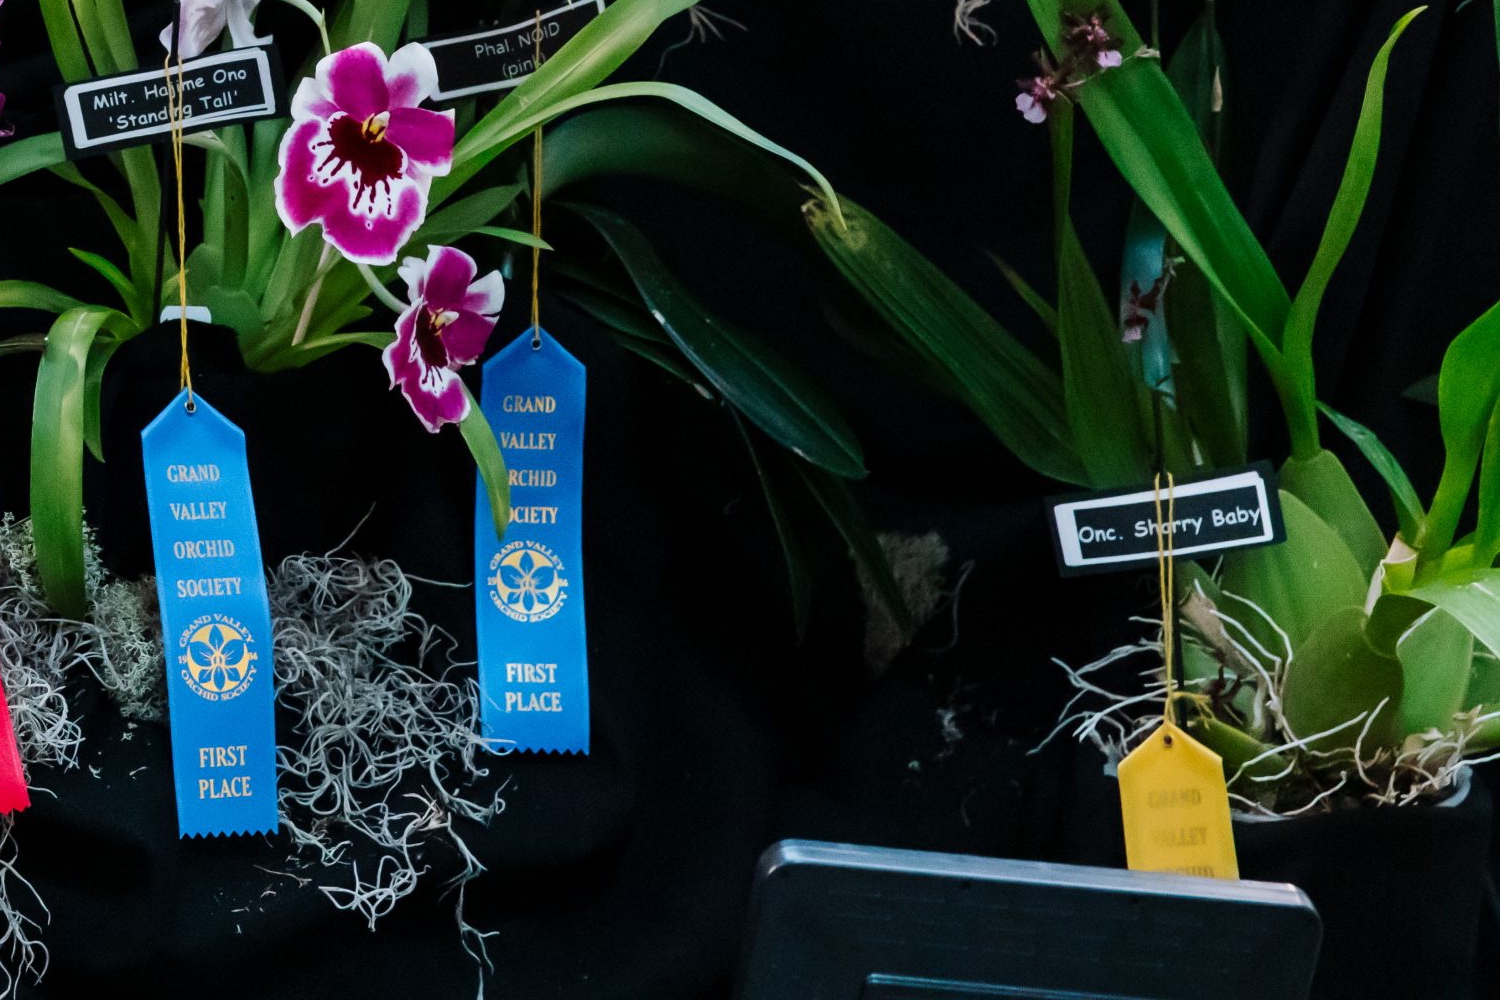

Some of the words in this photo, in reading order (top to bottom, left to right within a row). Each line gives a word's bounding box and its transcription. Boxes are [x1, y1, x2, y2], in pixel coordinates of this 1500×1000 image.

[474, 39, 514, 59] Phal.
[518, 21, 560, 48] NOID
[93, 92, 135, 111] Milt.
[212, 68, 247, 84] Ono
[109, 104, 193, 130] 'Standng
[198, 90, 238, 111] Tall'
[503, 395, 557, 414] GRAND
[500, 431, 557, 451] VALLEY
[166, 464, 220, 483] GRAND
[508, 469, 557, 488] RCHID
[169, 502, 227, 521] VALLEY
[508, 506, 558, 524] OCIETY
[1078, 525, 1124, 544] Onc.
[1134, 515, 1203, 539] Sharry
[1211, 505, 1261, 528] Baby
[173, 539, 235, 559] ORCHID
[490, 540, 524, 570] GRAND
[176, 577, 241, 598] SOCIETY
[179, 614, 211, 648] GRAND
[213, 613, 255, 643] VALLEY
[181, 669, 219, 701] ORCHID
[221, 664, 257, 701] SOCIETY
[505, 662, 558, 683] FIRST
[505, 691, 563, 712] PLACE
[199, 745, 248, 768] FIRST
[198, 776, 252, 799] PLACE
